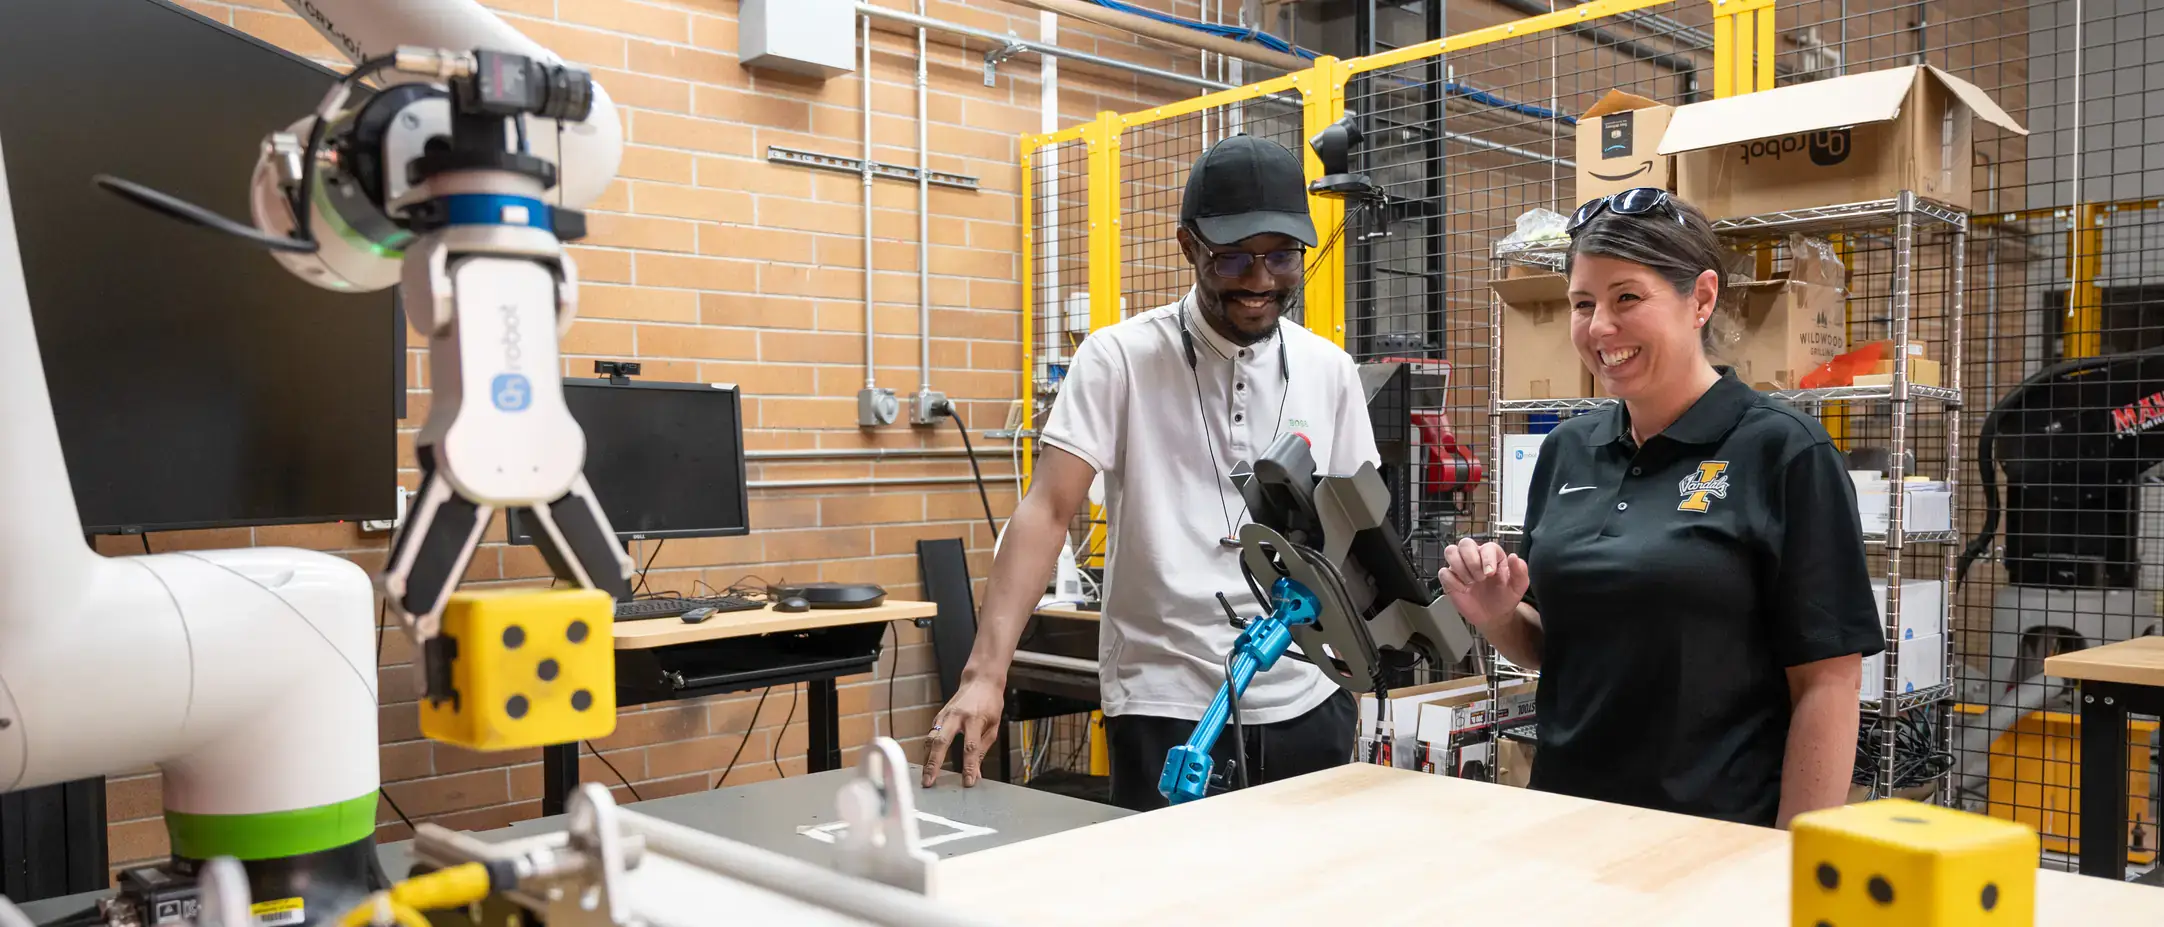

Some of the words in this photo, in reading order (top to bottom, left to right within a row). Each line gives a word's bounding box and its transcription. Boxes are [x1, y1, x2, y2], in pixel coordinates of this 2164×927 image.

[1740, 137, 1806, 165] robot
[1800, 332, 1843, 348] WILDWOOD
[1679, 475, 1729, 499] Vandals
